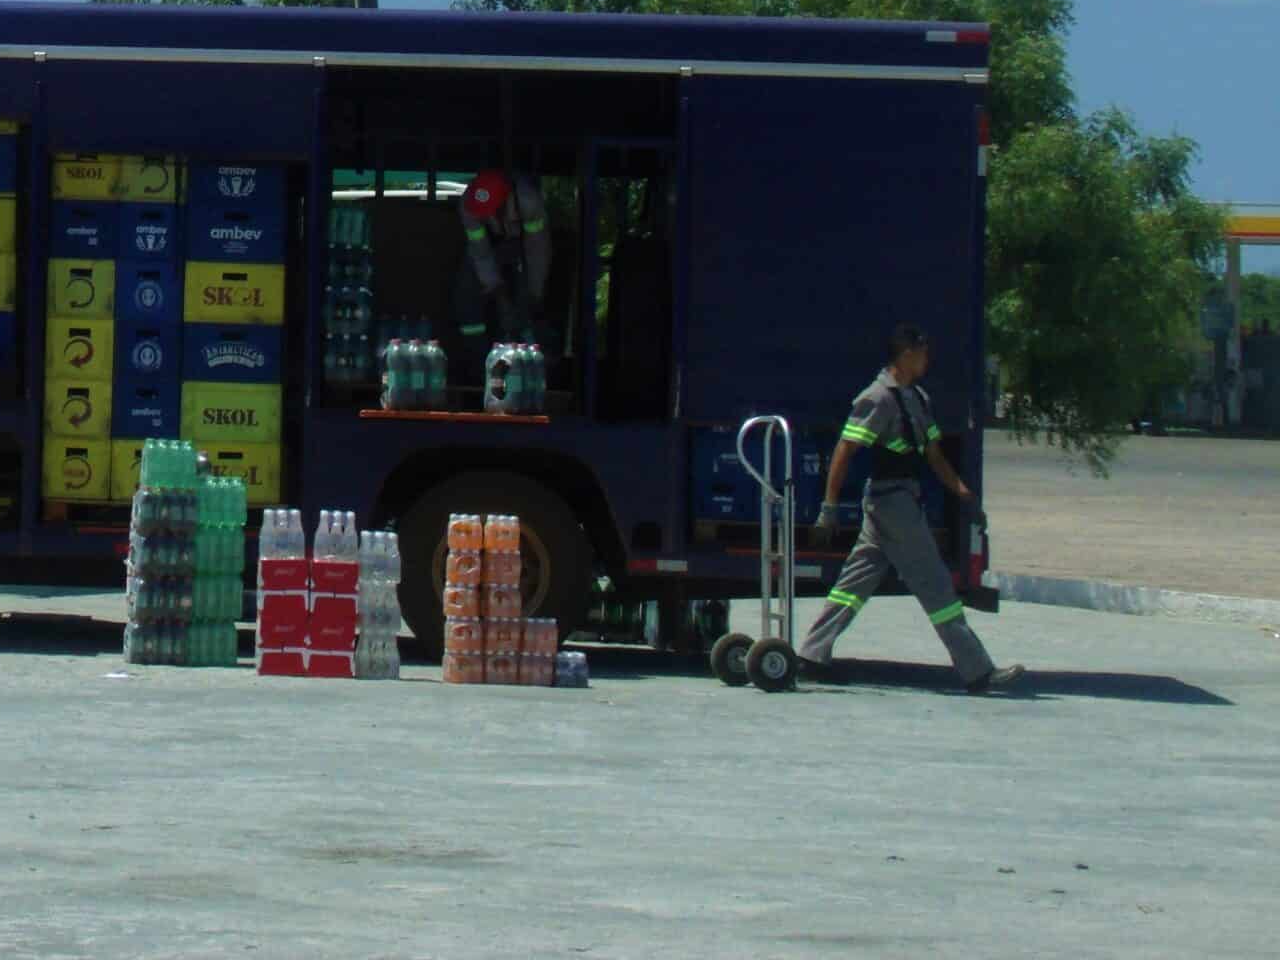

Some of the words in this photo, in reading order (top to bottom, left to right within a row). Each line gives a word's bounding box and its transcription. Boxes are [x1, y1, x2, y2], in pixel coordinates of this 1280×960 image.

[65, 167, 105, 180] SKOL
[209, 225, 263, 240] ambev
[202, 407, 260, 428] SKOL
